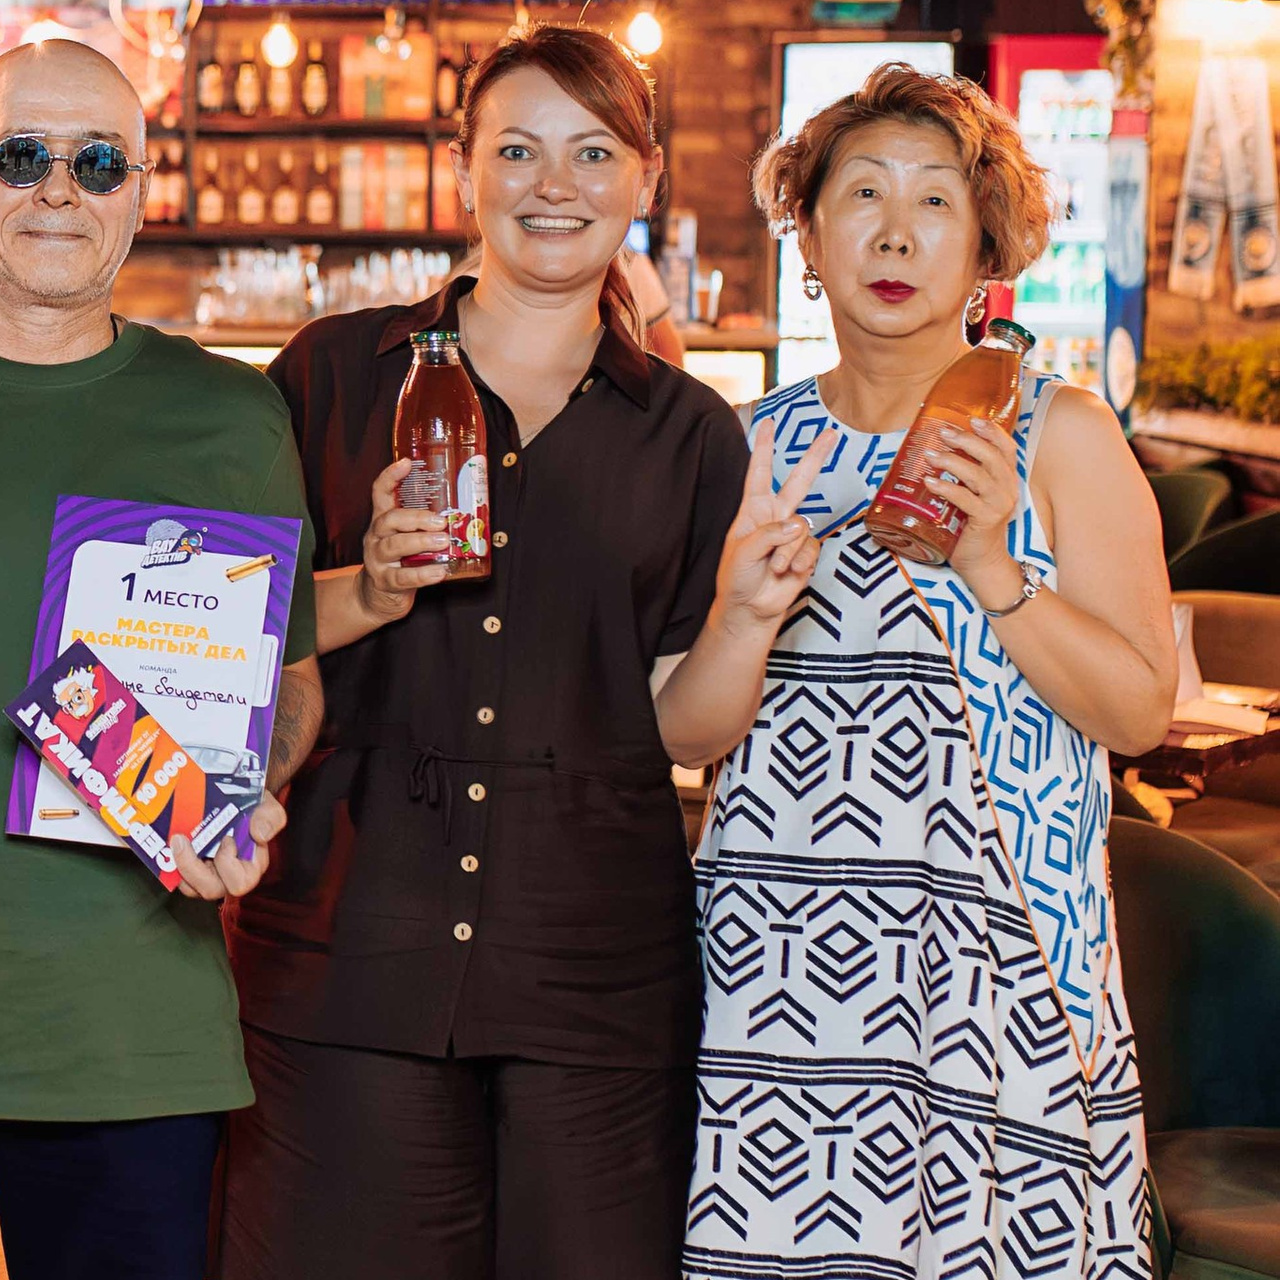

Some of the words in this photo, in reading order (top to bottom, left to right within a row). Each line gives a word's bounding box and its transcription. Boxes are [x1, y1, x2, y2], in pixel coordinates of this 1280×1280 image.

[120, 572, 136, 602] 1
[143, 588, 219, 611] МЕСТО
[71, 629, 199, 657] РАСКРЫТЫХ
[204, 644, 248, 662] ДЕЛ
[117, 617, 210, 641] МАСТЕРА
[154, 676, 248, 711] свидетели
[17, 702, 177, 873] СЕРТИФИКАТ
[135, 785, 158, 807] 10
[151, 749, 189, 790] 000
